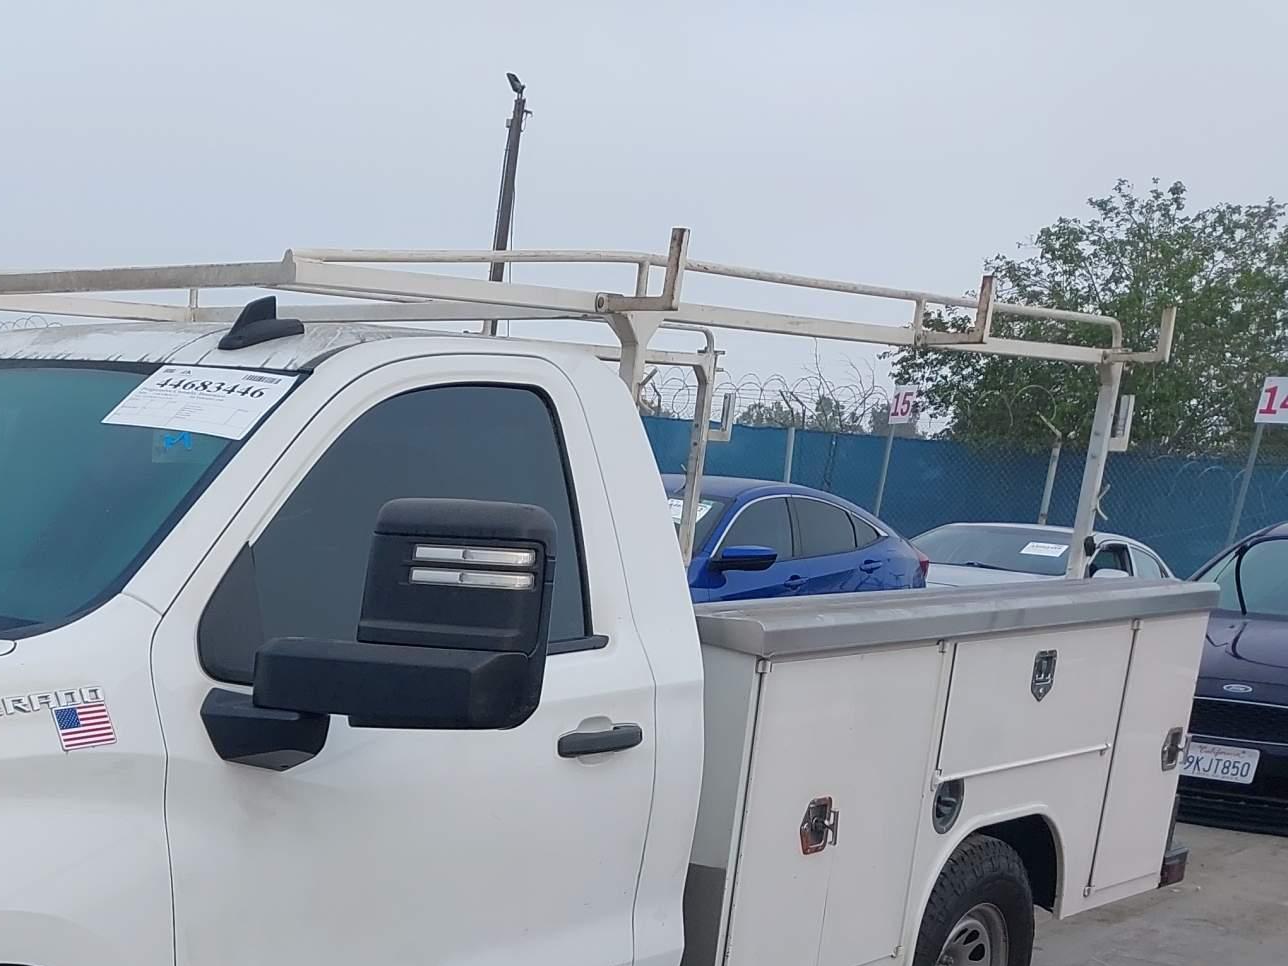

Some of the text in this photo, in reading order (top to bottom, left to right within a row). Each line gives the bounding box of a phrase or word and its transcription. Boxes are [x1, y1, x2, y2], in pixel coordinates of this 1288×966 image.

[156, 377, 269, 400] 44683446
[891, 391, 914, 416] 15
[1184, 754, 1251, 778] 9KJT850
